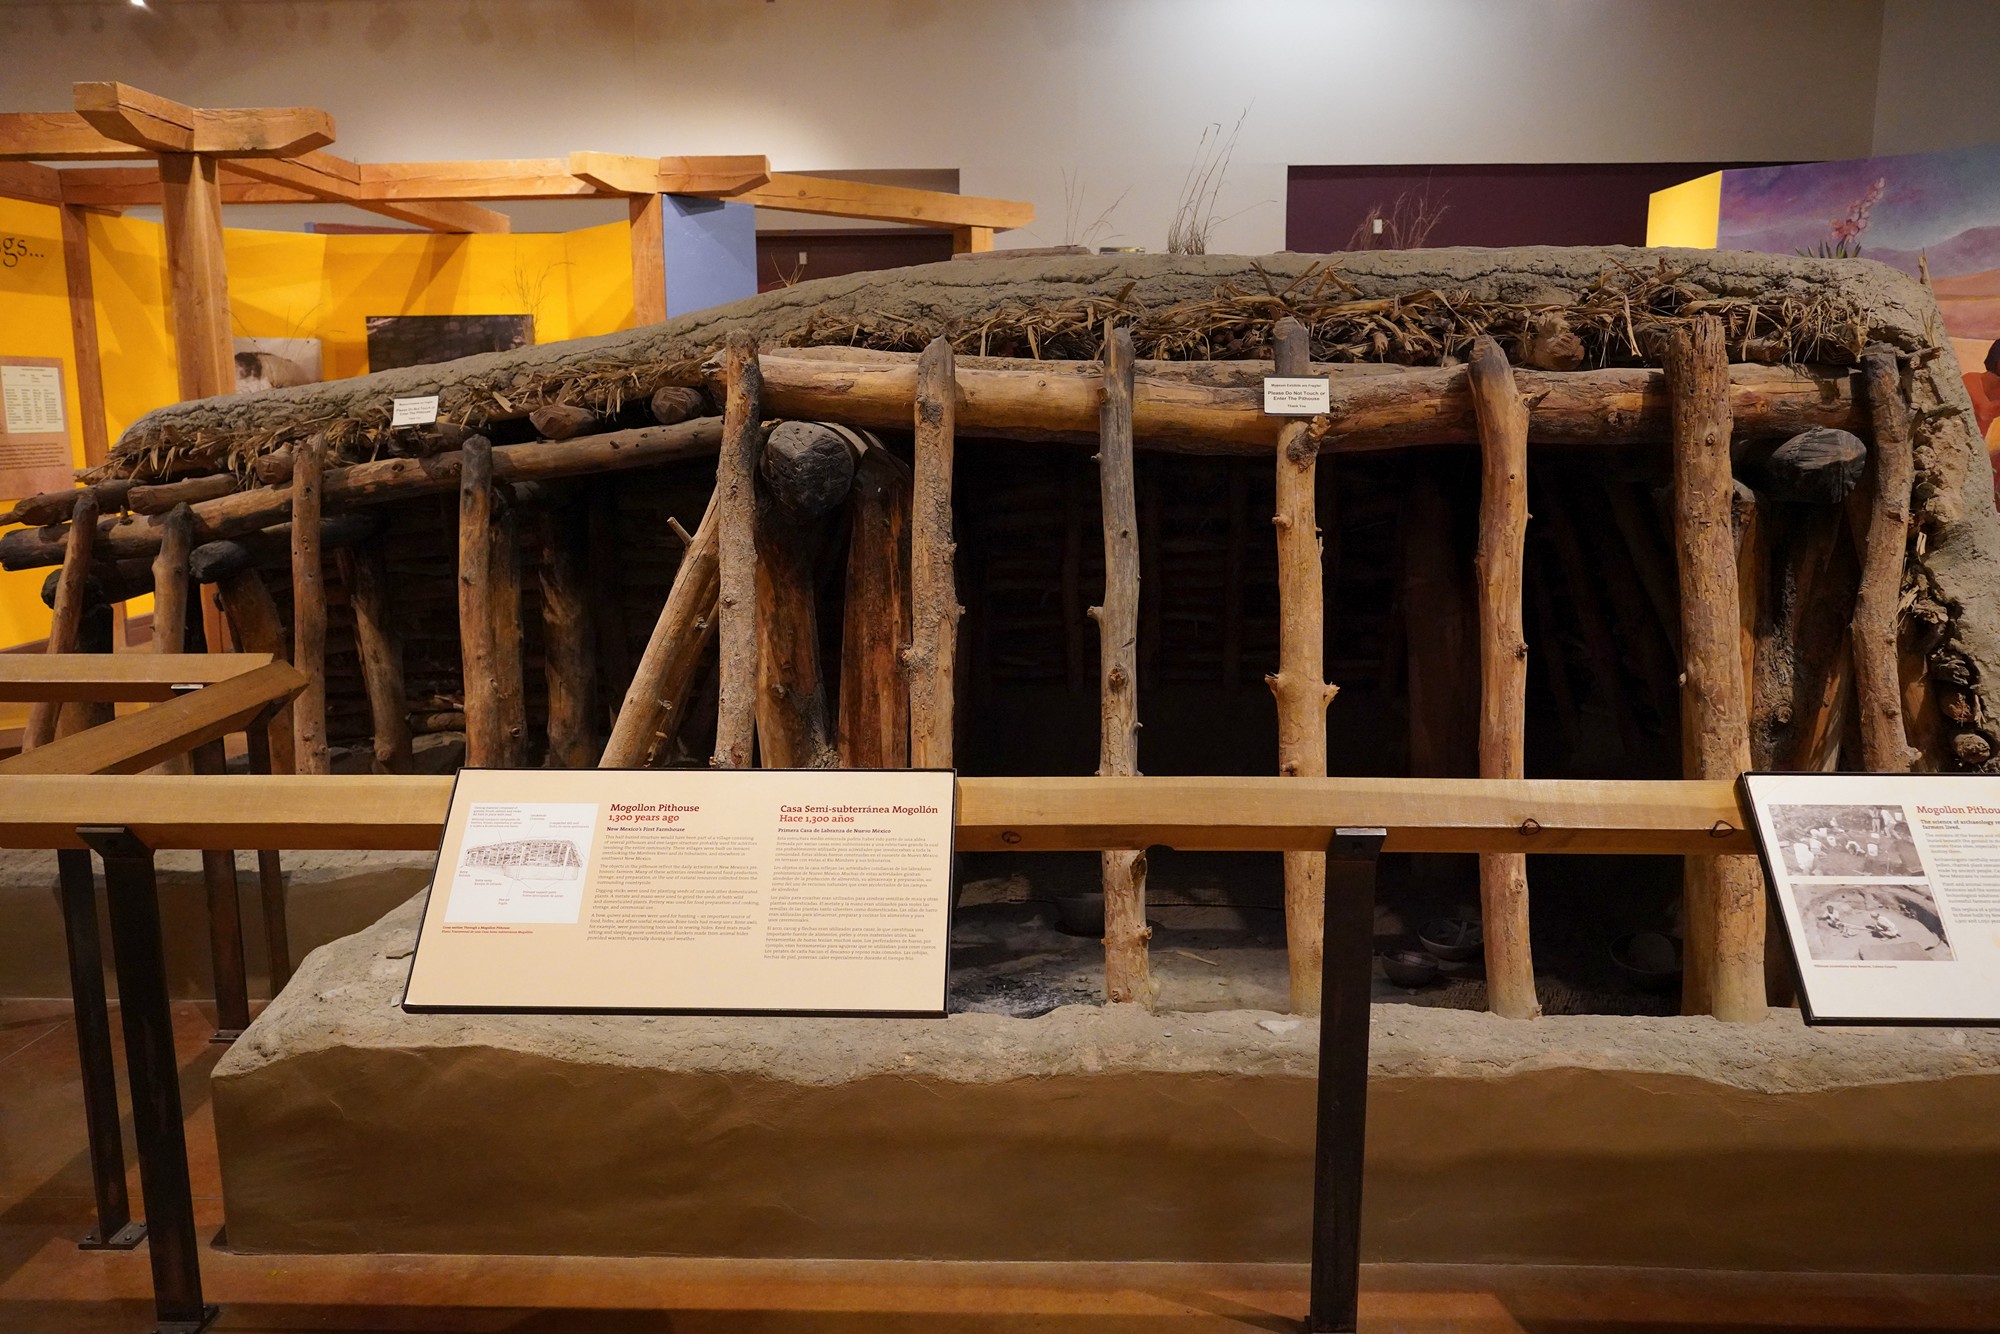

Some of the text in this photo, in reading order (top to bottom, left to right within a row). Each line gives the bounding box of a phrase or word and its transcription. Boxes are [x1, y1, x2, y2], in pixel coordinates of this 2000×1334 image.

[0, 238, 44, 268] gs...
[610, 804, 700, 814] Mogollon Pithouse
[805, 805, 889, 813] Semi-subterránea
[892, 806, 938, 816] Mogollón
[1916, 806, 1965, 816] Mogollon
[634, 814, 660, 823] years
[662, 814, 680, 823] ago
